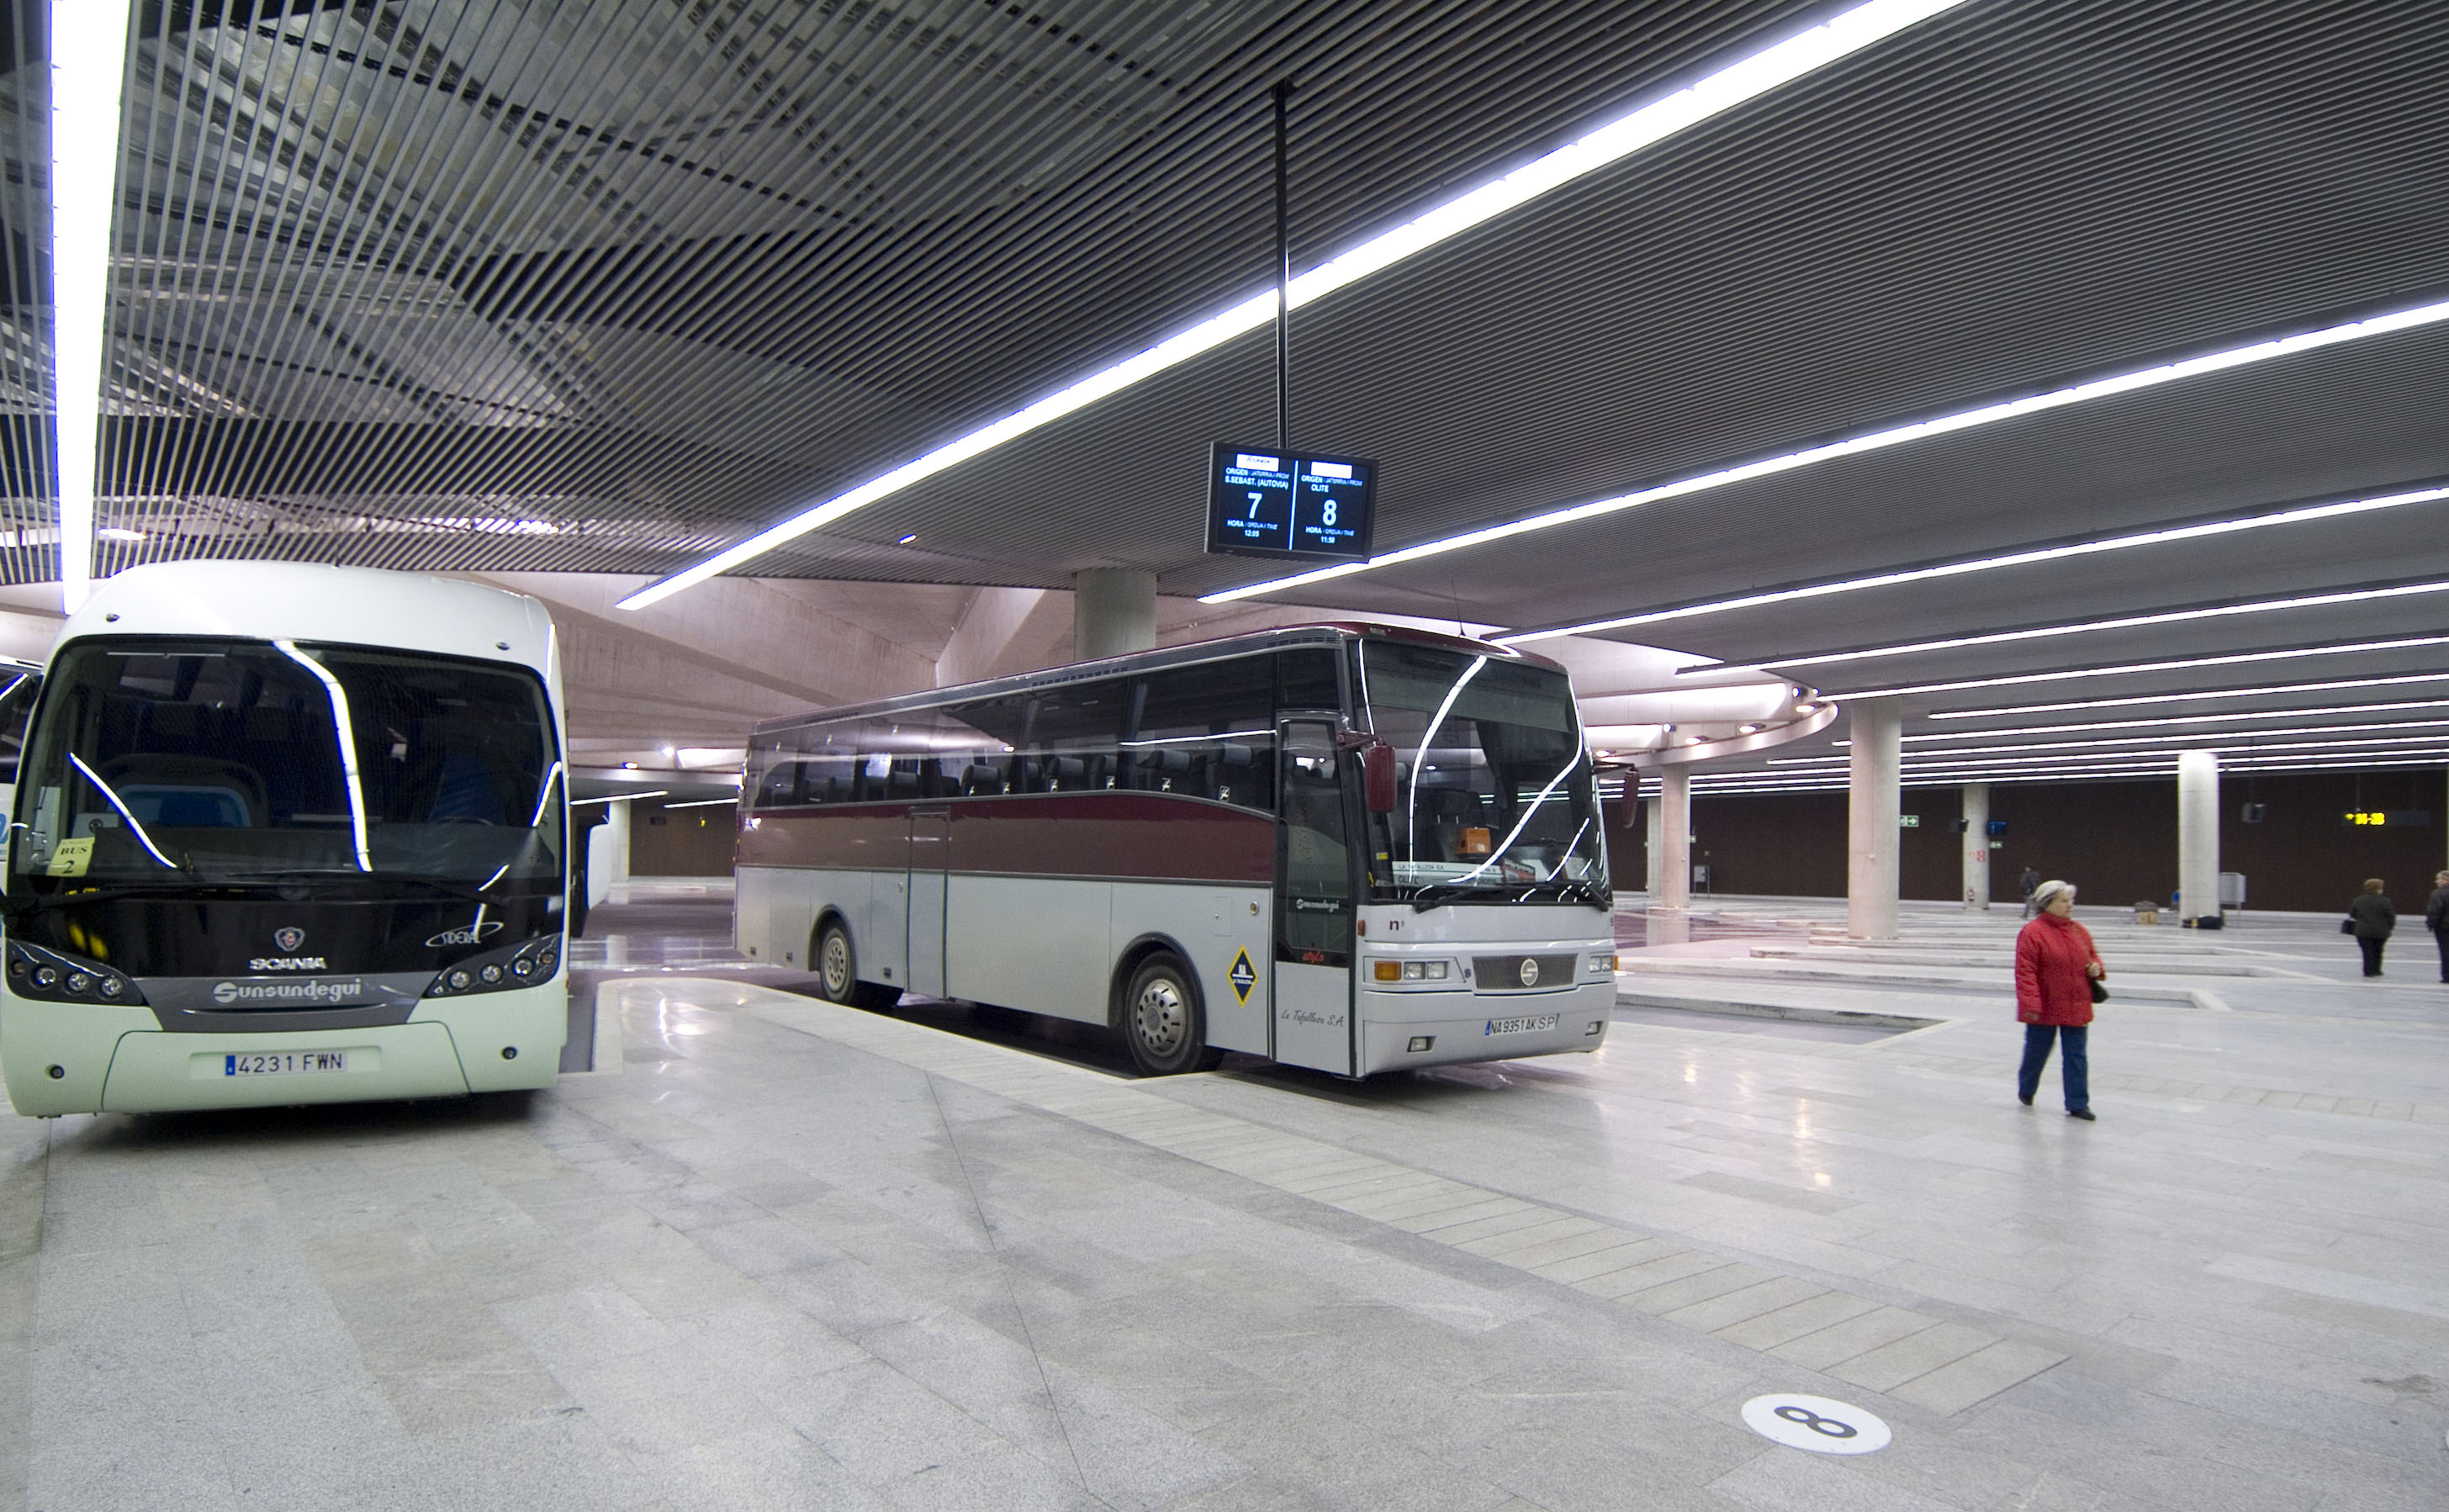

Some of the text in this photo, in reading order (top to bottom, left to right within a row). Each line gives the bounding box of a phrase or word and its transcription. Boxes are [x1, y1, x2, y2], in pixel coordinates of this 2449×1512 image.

[1225, 467, 1248, 476] ORIGEN
[1301, 474, 1323, 483] ORIGEN
[1311, 483, 1329, 493] OLITE
[1247, 492, 1262, 519] 7
[1322, 499, 1337, 526] 8
[1227, 519, 1244, 527] HORA
[1305, 526, 1322, 534] HORA
[62, 860, 74, 874] 2
[249, 957, 327, 970] SCANIA
[214, 978, 362, 1003] Sunsundegui
[1281, 1010, 1289, 1019] La
[239, 1053, 342, 1073] 4231 FWN
[1774, 1406, 1858, 1438] 8
